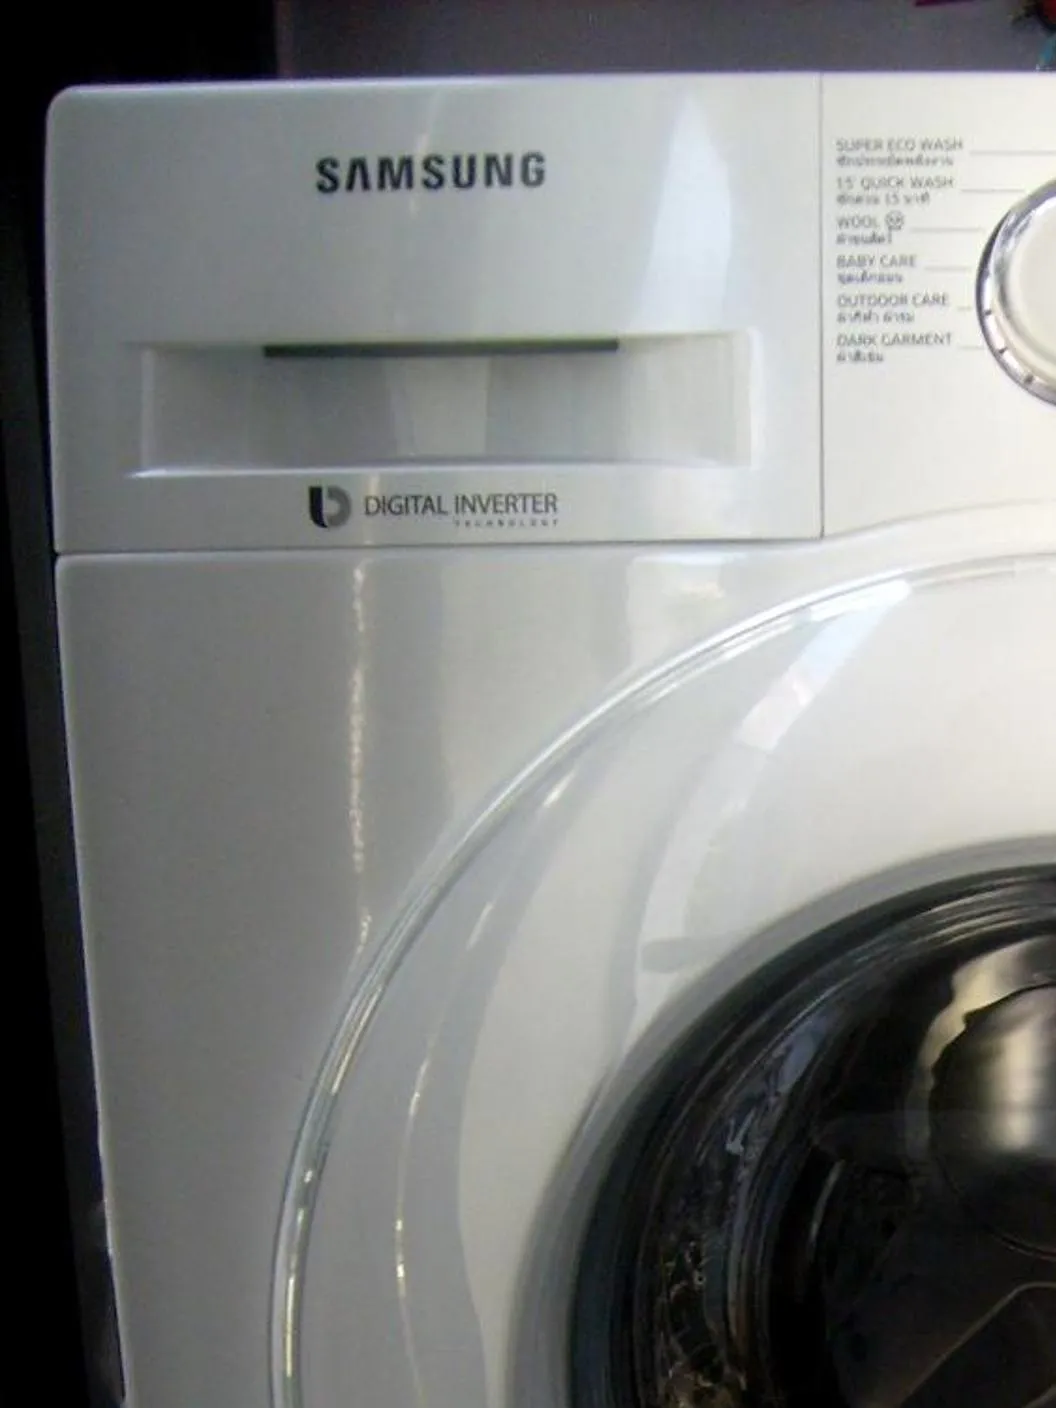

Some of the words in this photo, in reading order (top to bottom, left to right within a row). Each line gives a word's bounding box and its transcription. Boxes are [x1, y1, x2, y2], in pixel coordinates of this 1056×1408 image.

[836, 138, 882, 151] SUPER
[887, 138, 915, 151] ECO
[920, 136, 963, 151] WASH
[315, 151, 546, 194] SAMSUNG
[860, 177, 904, 191] QUICK
[909, 176, 954, 189] WASH
[836, 216, 878, 229] WOOL
[836, 254, 874, 268] BABY
[879, 254, 917, 267] CARE
[836, 293, 908, 307] OUTDOOR
[911, 292, 948, 307] CARE
[836, 333, 876, 347] DARK
[880, 332, 951, 346] GARMENT
[364, 495, 448, 516] DIGITAL
[455, 493, 558, 514] INVERTER
